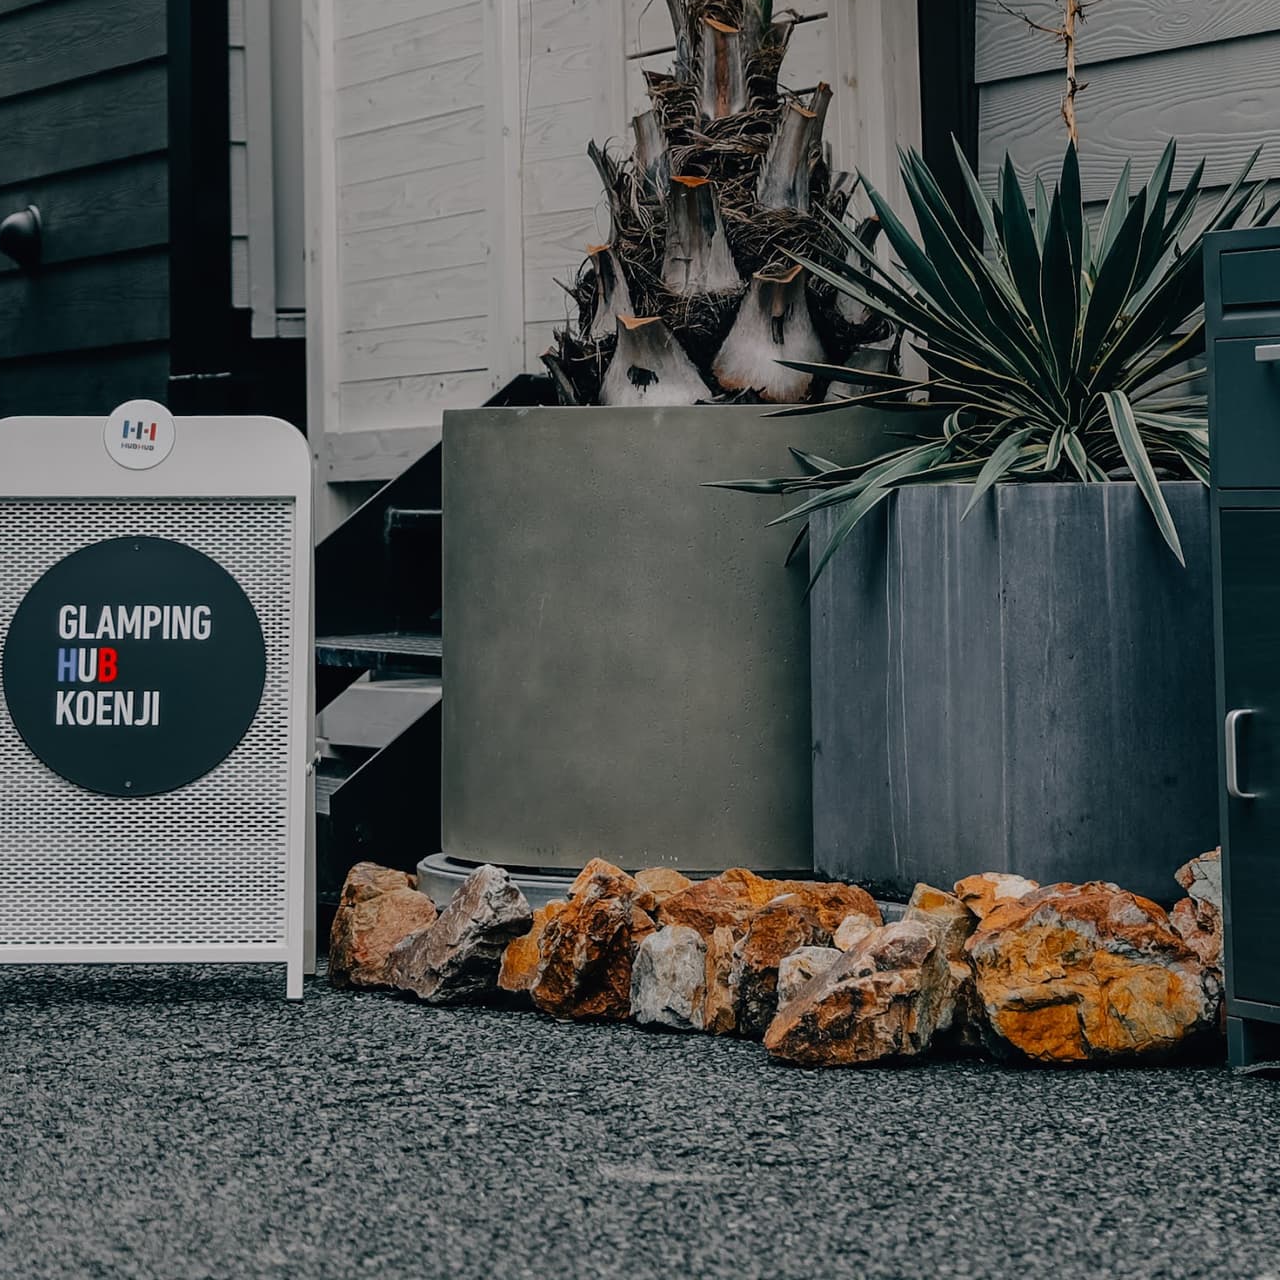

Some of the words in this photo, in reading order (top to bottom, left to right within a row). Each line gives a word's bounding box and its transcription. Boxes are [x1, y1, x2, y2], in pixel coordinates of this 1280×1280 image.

[59, 604, 211, 640] GLAMPING
[58, 647, 118, 683] HUB
[56, 690, 160, 726] KOENJI
